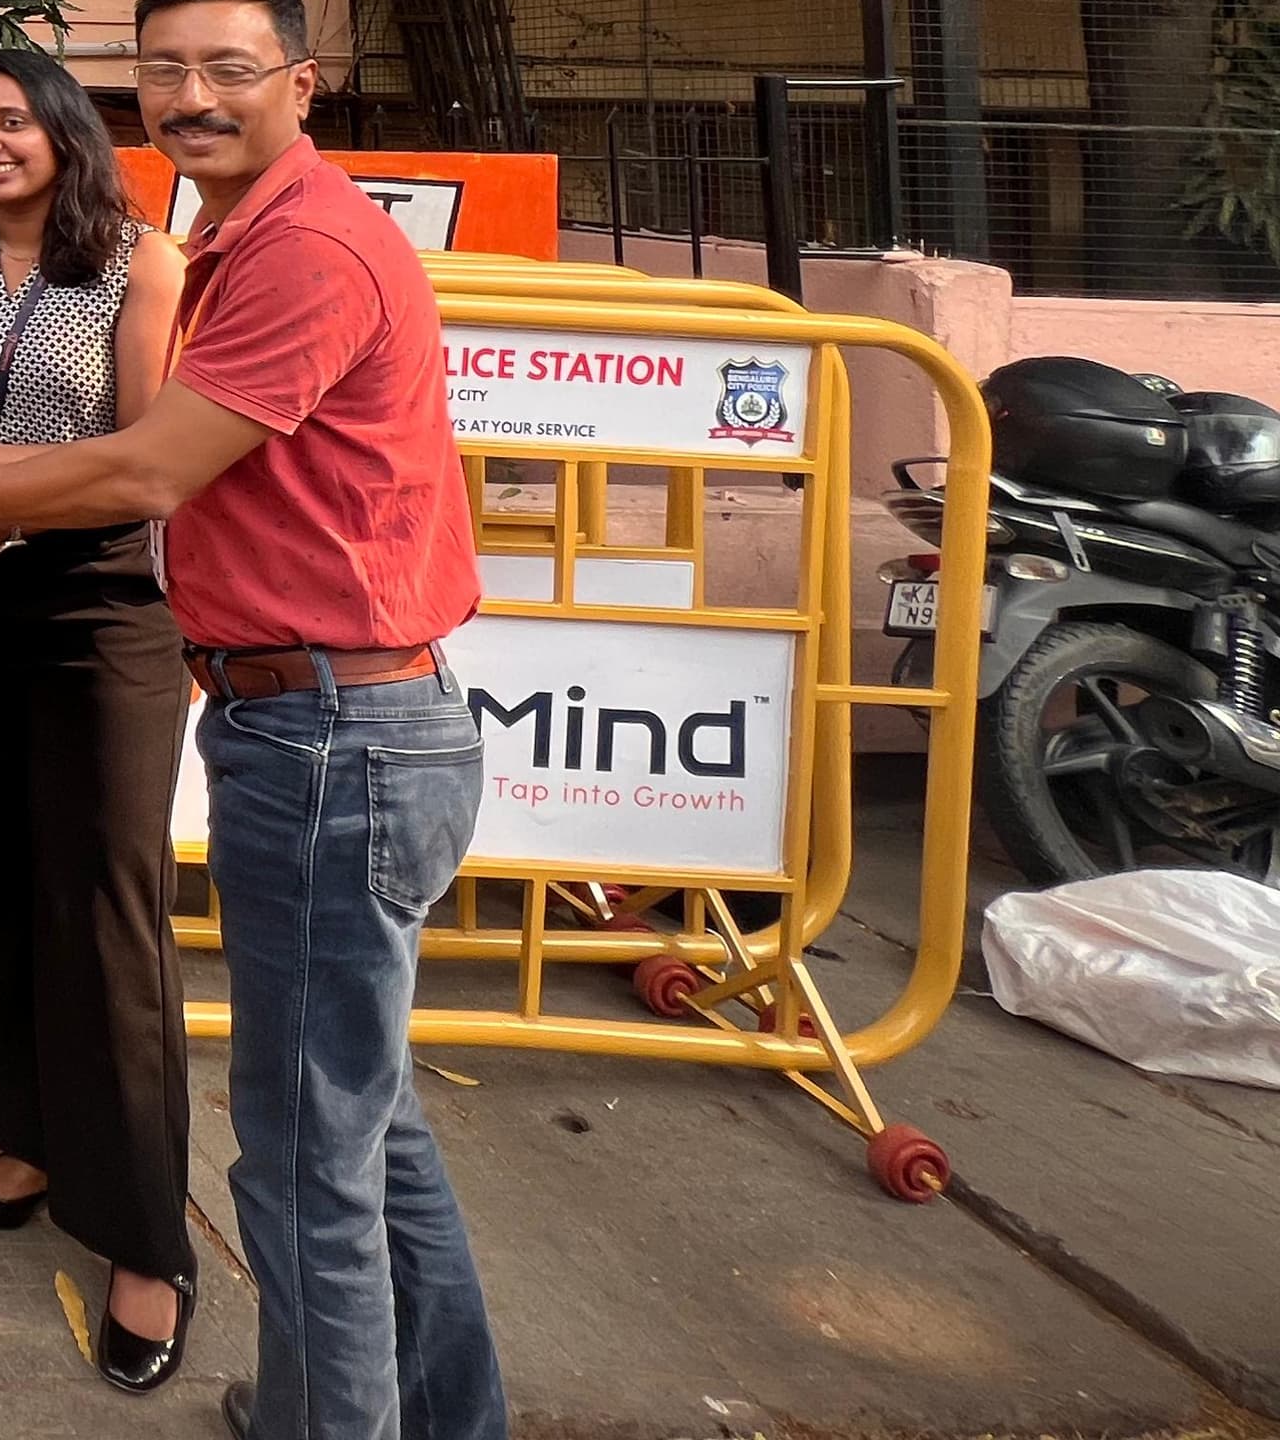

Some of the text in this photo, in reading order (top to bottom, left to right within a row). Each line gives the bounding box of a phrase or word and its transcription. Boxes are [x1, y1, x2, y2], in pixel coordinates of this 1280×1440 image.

[443, 346, 684, 387] LICE STATION
[457, 388, 489, 402] CITY
[469, 419, 489, 433] AT
[490, 420, 532, 435] YOUR
[536, 422, 596, 438] SERVICE
[467, 685, 746, 778] Mind
[492, 776, 745, 812] Tap into Growth
